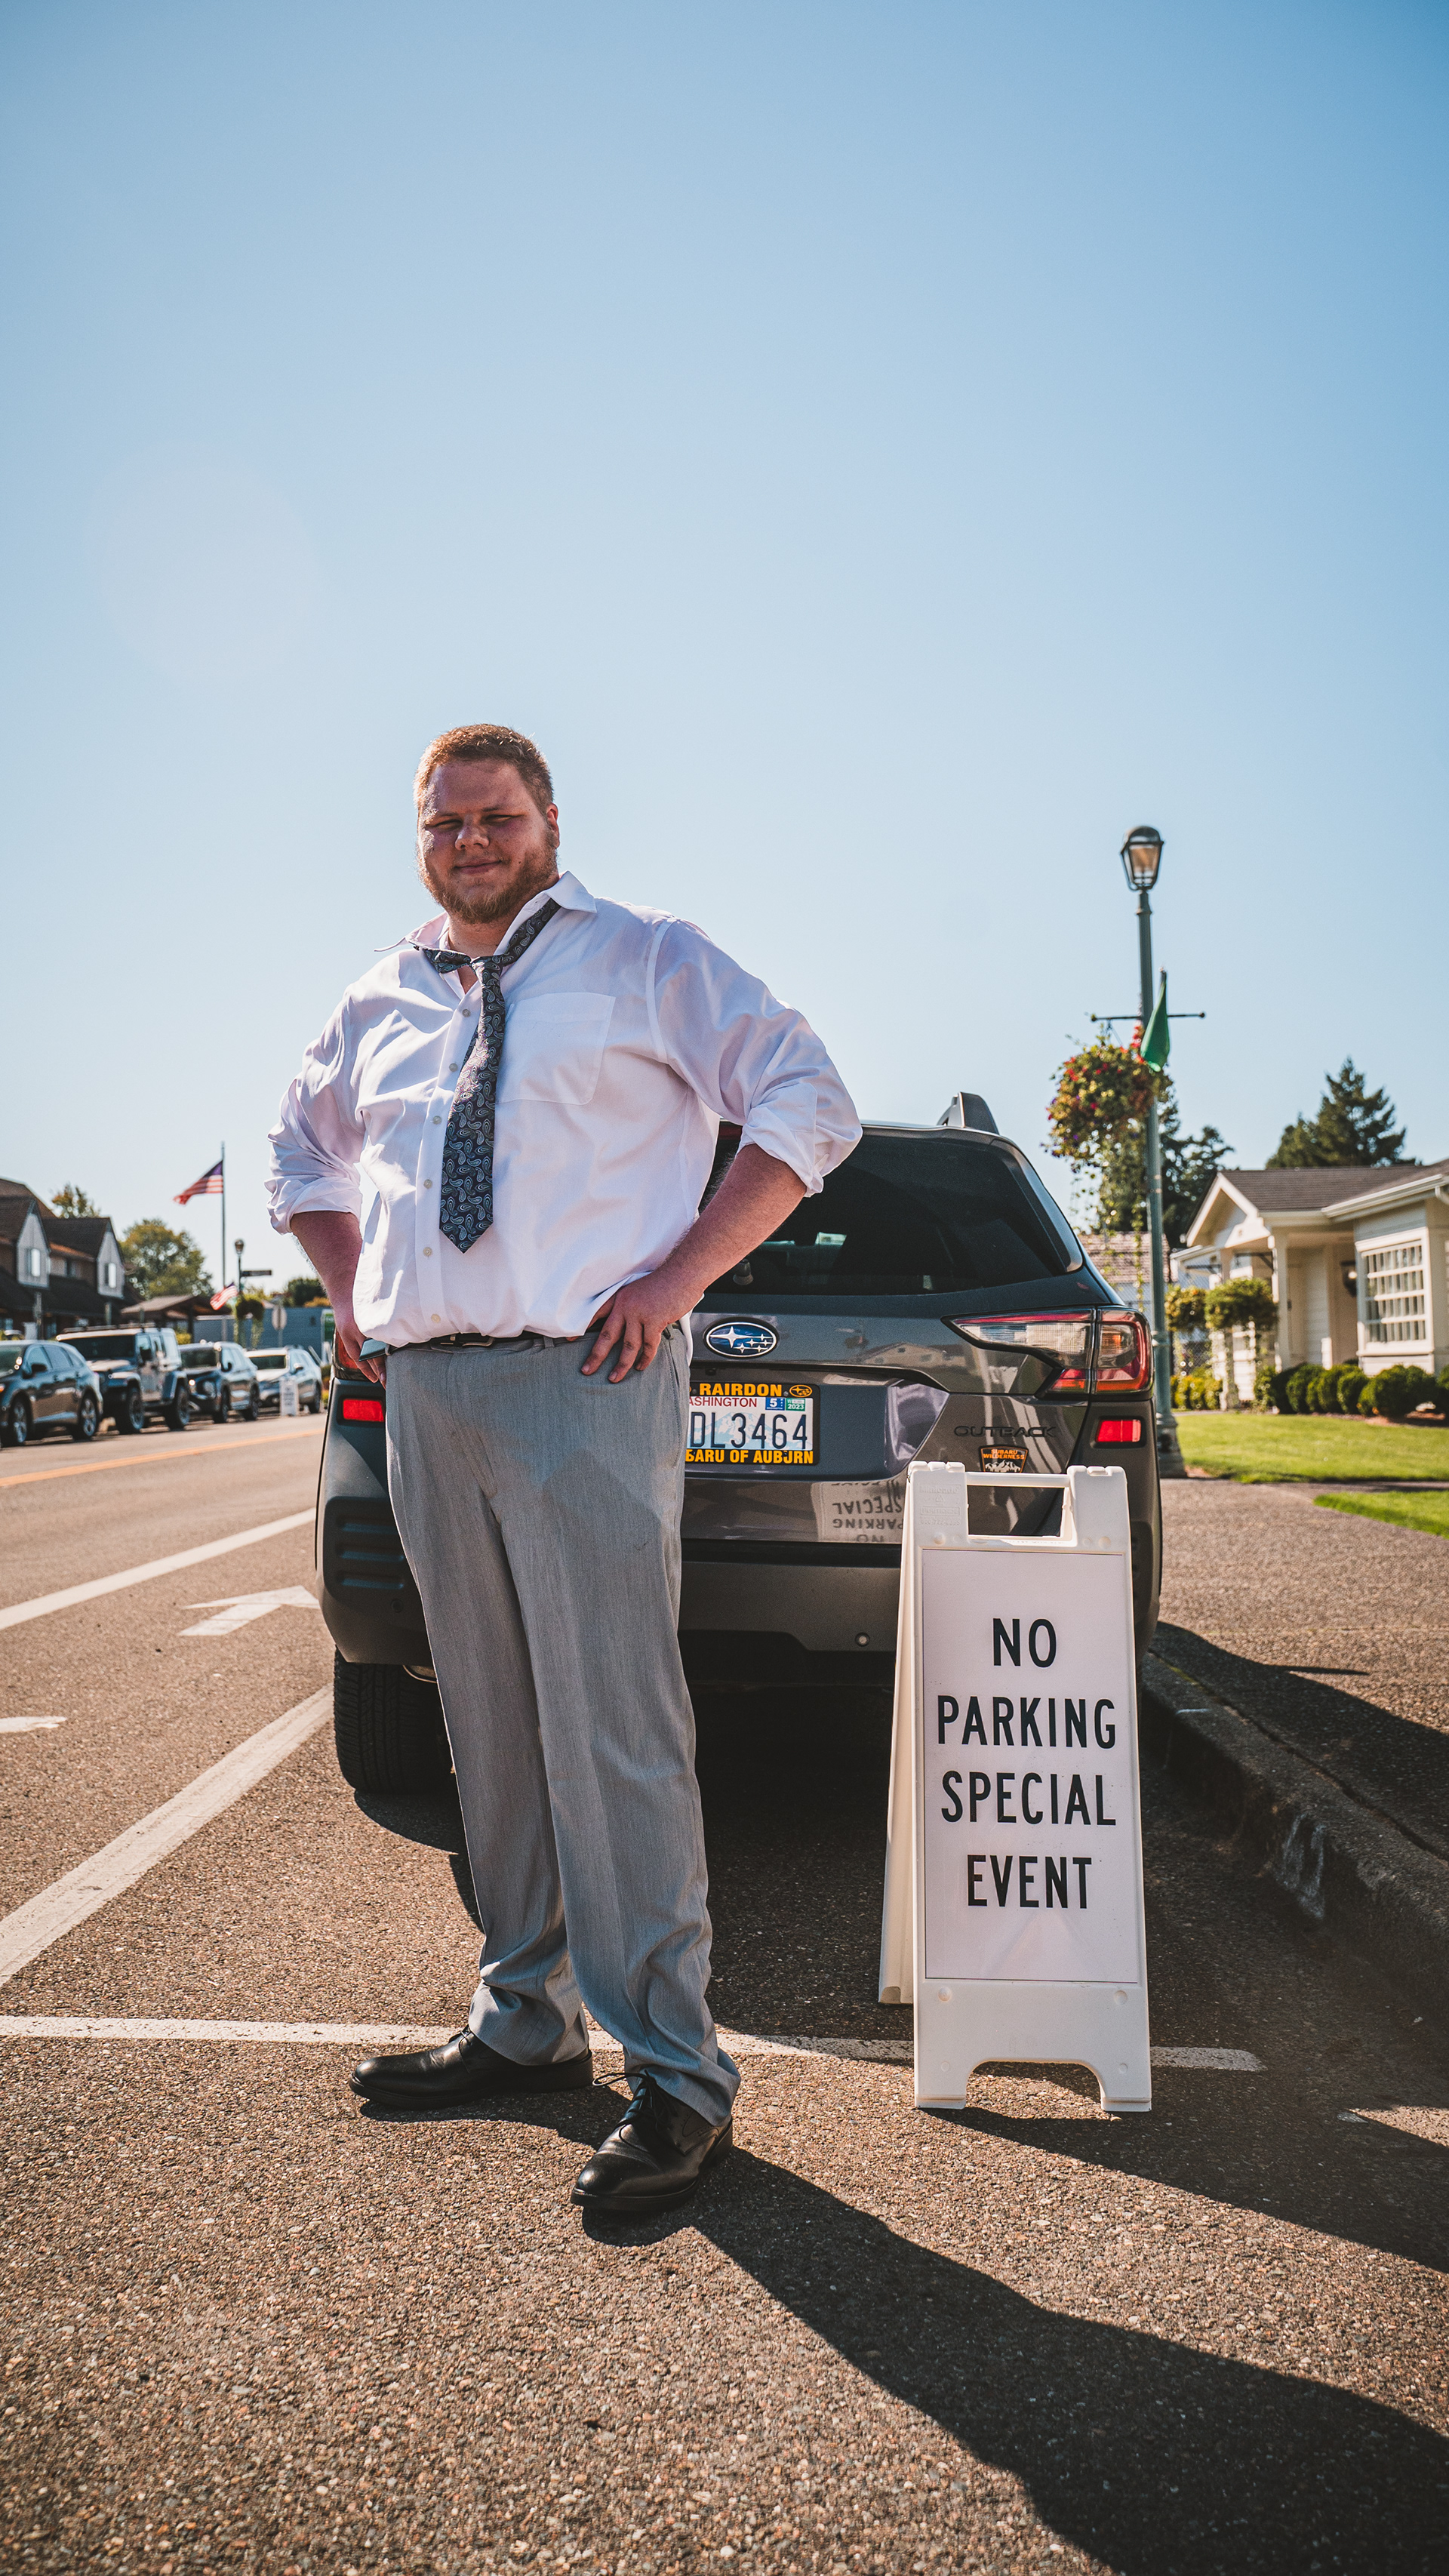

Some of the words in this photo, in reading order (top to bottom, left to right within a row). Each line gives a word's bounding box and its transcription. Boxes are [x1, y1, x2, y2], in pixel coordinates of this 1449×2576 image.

[700, 1383, 782, 1397] RAIRDON
[770, 1398, 777, 1408] 5
[954, 1426, 1057, 1438] OUTBACK
[730, 1450, 749, 1463] OF
[753, 1450, 814, 1464] AUBURN
[992, 1617, 1057, 1668] NO
[937, 1694, 1116, 1750] PARKING
[940, 1770, 1116, 1826] SPECIAL
[967, 1854, 1092, 1910] EVENT
